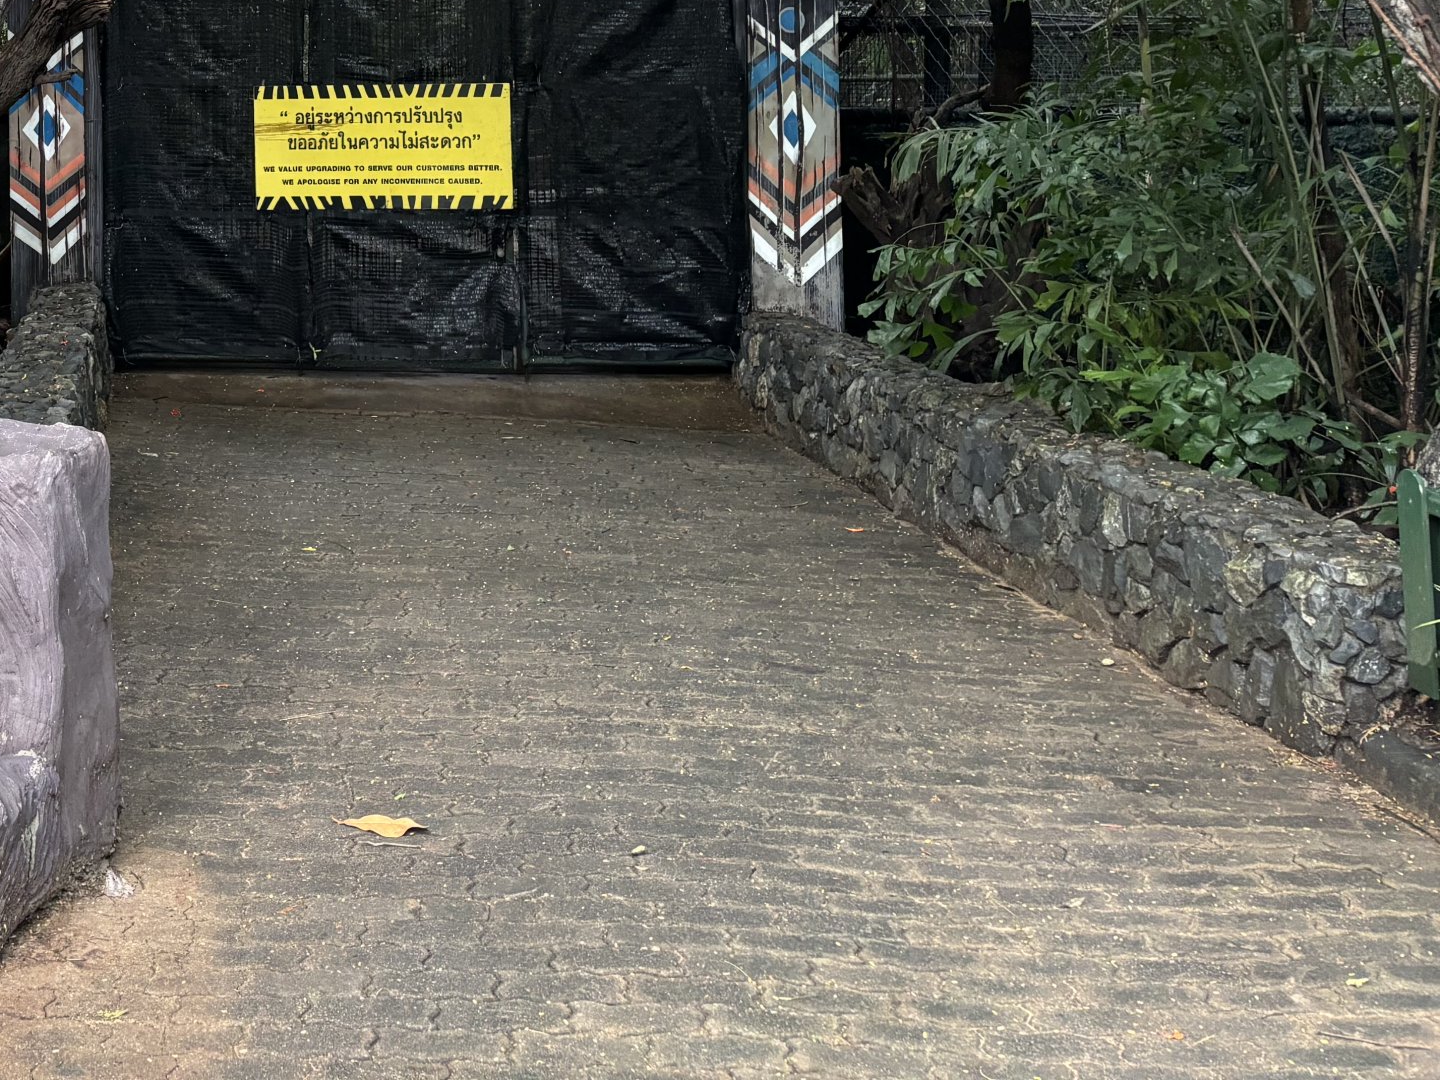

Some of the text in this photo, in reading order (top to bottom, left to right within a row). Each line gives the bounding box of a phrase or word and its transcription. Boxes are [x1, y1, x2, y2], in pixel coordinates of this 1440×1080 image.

[263, 165, 276, 173] WE
[278, 165, 303, 173] VALUE
[306, 165, 352, 173] UPGRADING
[396, 164, 413, 172] OUR
[416, 164, 465, 172] CUSTOMERS
[468, 164, 503, 172] BETTER.
[282, 178, 294, 186] WE
[381, 177, 445, 185] INCONVENIENCE
[448, 177, 483, 185] CAUSED.
